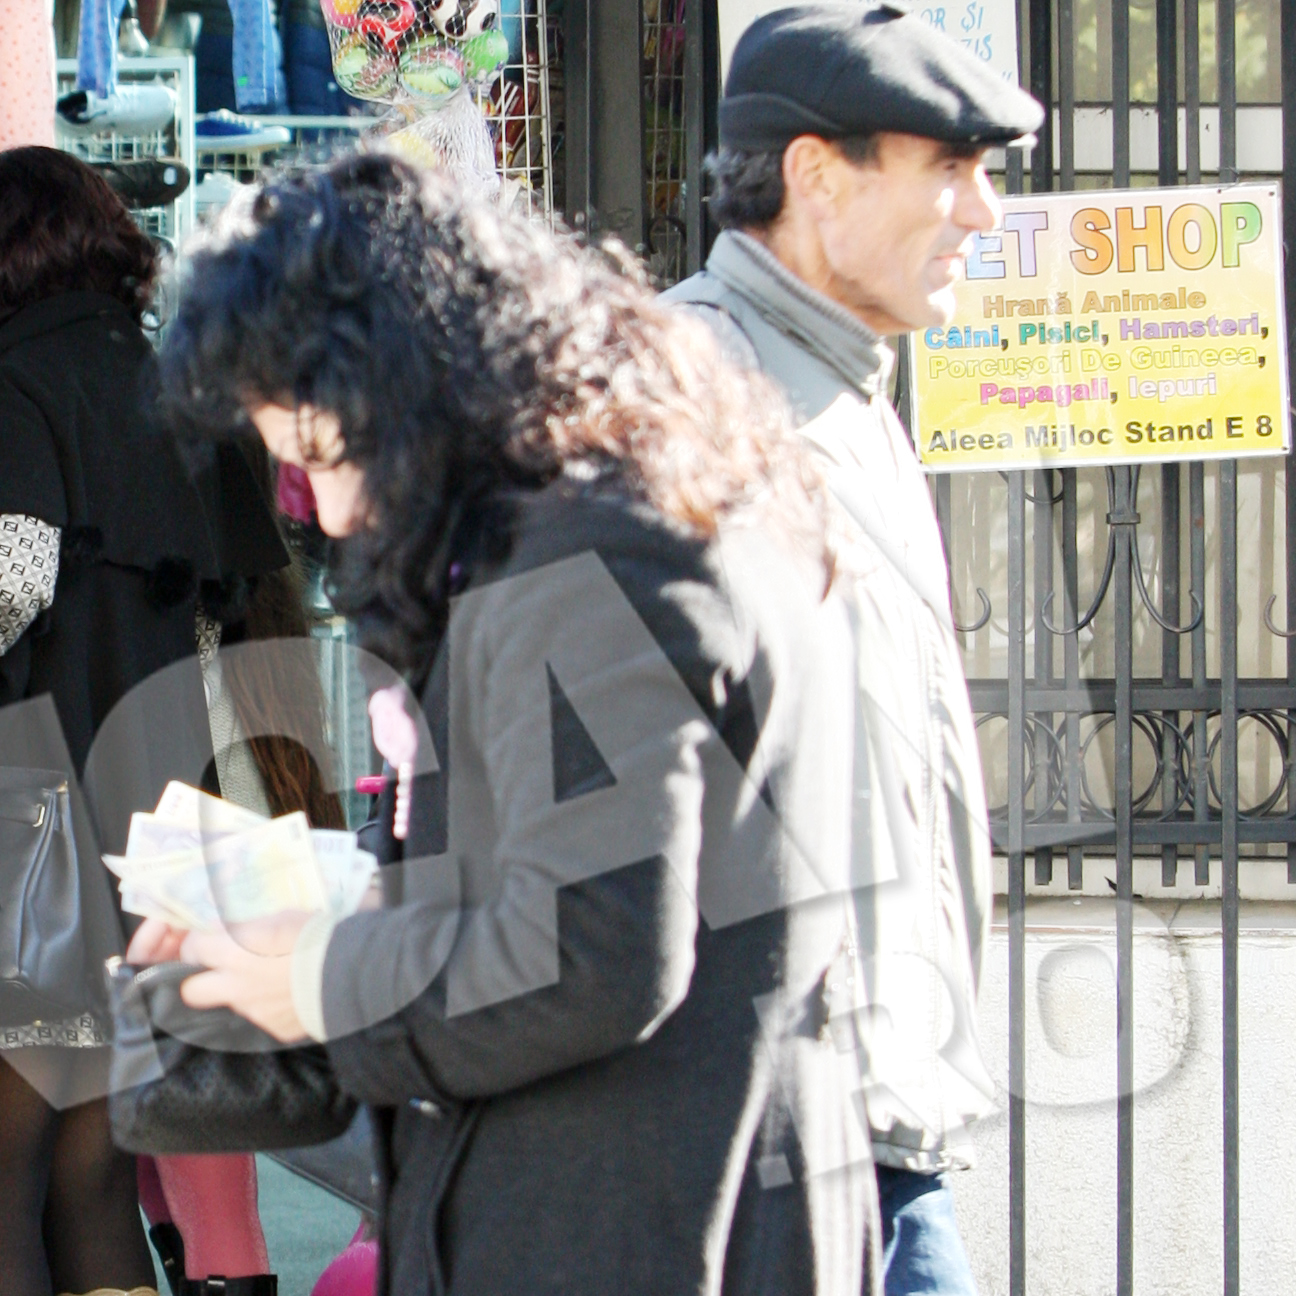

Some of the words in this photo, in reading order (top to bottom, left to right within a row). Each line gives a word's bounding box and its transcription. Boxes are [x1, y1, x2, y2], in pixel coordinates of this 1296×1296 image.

[965, 211, 1048, 281] ET
[1069, 201, 1263, 276] SHOP
[983, 291, 1073, 320] Hrană
[1081, 286, 1207, 315] Animale
[924, 324, 1009, 351] Câini,
[1019, 319, 1110, 347] Pisici,
[1120, 312, 1270, 342] Hamsteri,
[1082, 348, 1121, 373] De
[1129, 344, 1266, 372] Guineea,
[980, 377, 1119, 409] Papagali,
[1129, 373, 1218, 403] Iepuri
[928, 429, 1014, 453] Aleea
[1025, 424, 1114, 452] Mijloc
[1125, 417, 1214, 445] Stand
[1226, 415, 1245, 440] E
[1256, 414, 1274, 438] 8
